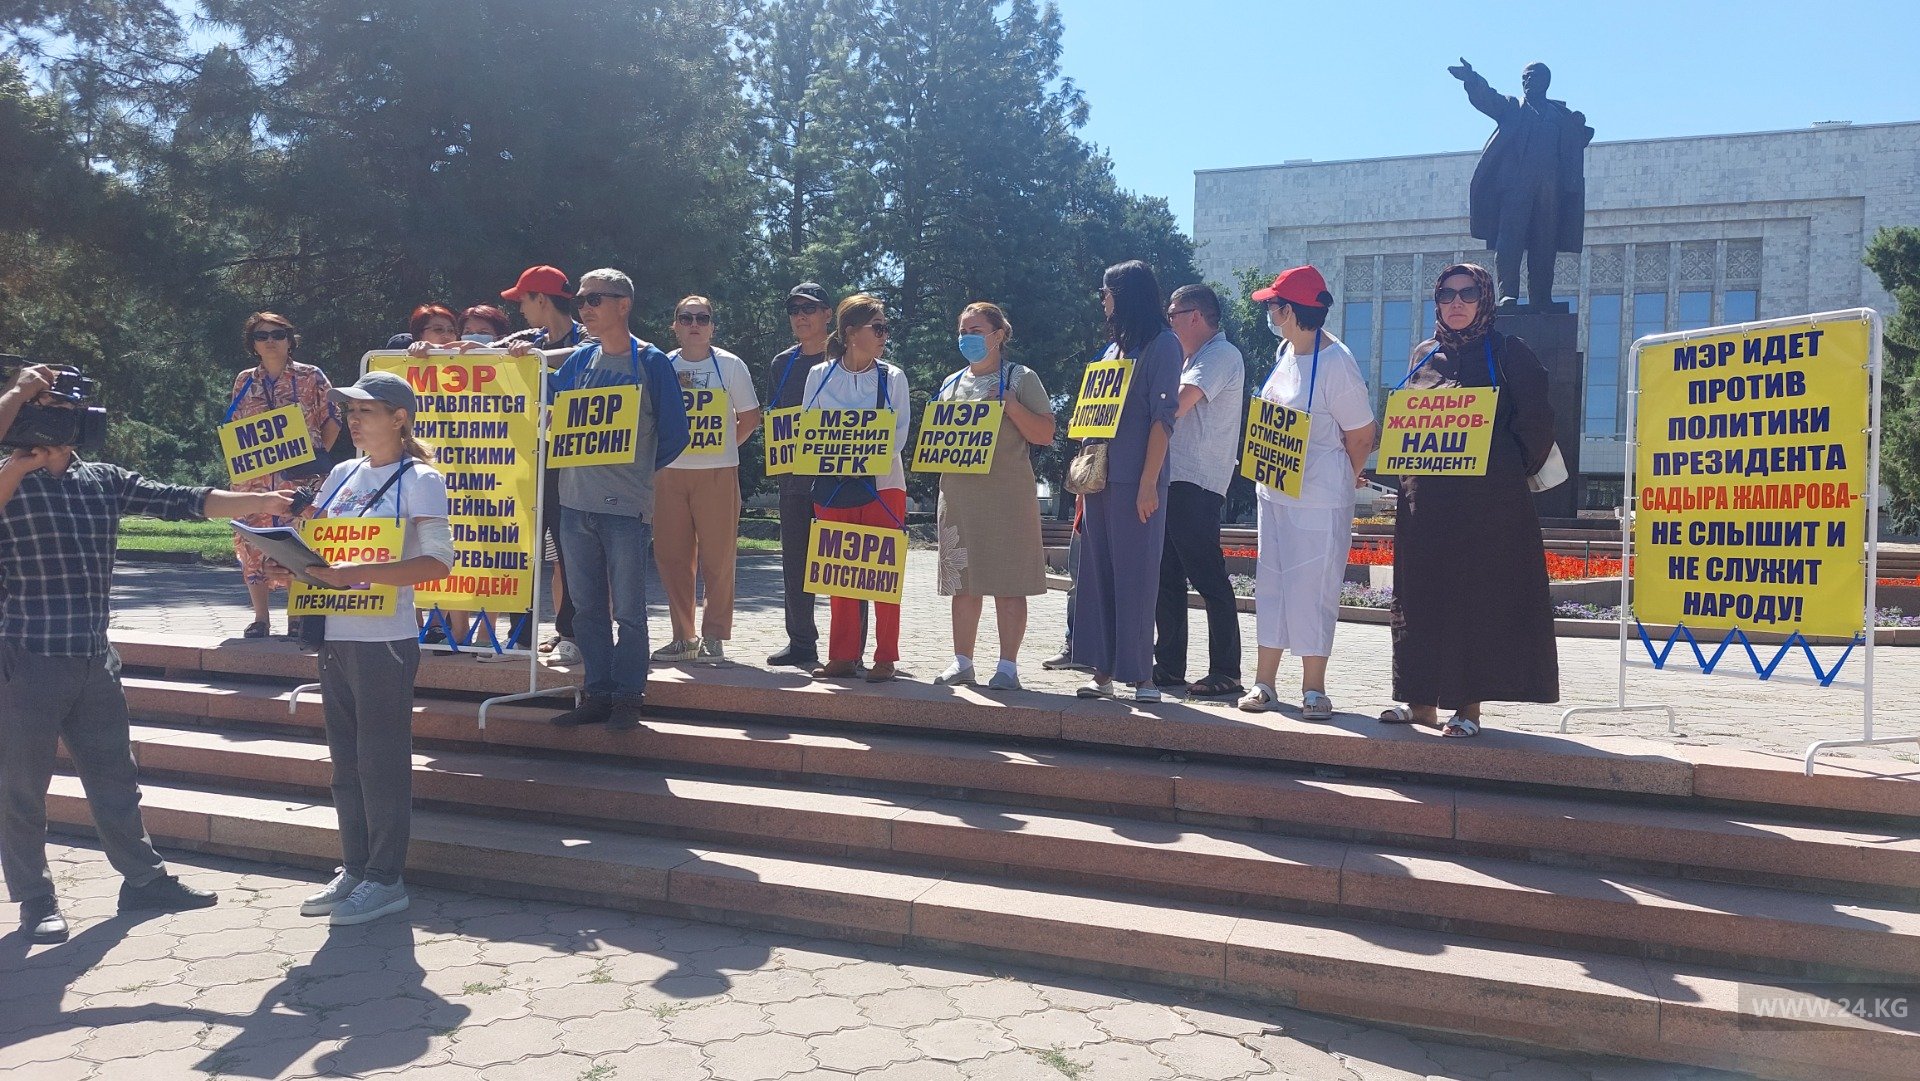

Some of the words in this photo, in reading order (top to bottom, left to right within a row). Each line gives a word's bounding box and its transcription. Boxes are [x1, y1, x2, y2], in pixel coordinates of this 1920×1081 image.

[1673, 341, 1735, 371] МЭР
[1743, 330, 1824, 366] ИДЕТ
[406, 364, 497, 393] МЭР
[1082, 367, 1126, 400] МЭРА
[1688, 370, 1806, 404] ПРОТИВ
[415, 395, 525, 413] ПРАВЛЯЕТСЯ
[567, 394, 623, 428] МЭР
[682, 390, 714, 412] ЭР
[1406, 394, 1477, 412] САДЫР
[687, 415, 723, 430] ТИВ
[820, 410, 877, 428] МЭР
[932, 403, 990, 426] МЭР
[1260, 401, 1297, 432] МЭР
[1387, 414, 1490, 430] ЖАПАРОВ-
[1668, 406, 1830, 441] ПОЛИТИКИ
[234, 413, 288, 451] МЭР
[552, 429, 632, 458] КЕТСИН!
[690, 432, 723, 450] ДА!
[804, 429, 890, 441] ОТМЕНИЛ
[920, 430, 993, 447] ПРОТИВ
[1250, 423, 1303, 454] ОТМЕНИЛ
[1401, 431, 1468, 453] НАШ
[230, 436, 308, 475] КЕТСИН!
[434, 446, 516, 465] ИСТКИМИ
[769, 446, 778, 467] В
[780, 443, 798, 465] ОТ
[802, 443, 888, 456] РЕШЕНИЕ
[918, 447, 988, 467] НАРОДА!
[1247, 440, 1301, 473] РЕШЕНИЕ
[1653, 443, 1847, 477] ПРЕЗИДЕНТА
[818, 456, 869, 474] БГК
[1255, 459, 1287, 491] БГК
[1386, 456, 1477, 472] ПРЕЗИДЕНТ!
[445, 473, 503, 492] ДАМИ-
[447, 494, 516, 517] ЕЙНЫЙ
[1641, 485, 1729, 514] САДЫРА
[1733, 482, 1858, 510] ЖАПАРОВА-
[313, 525, 381, 543] САДЫР
[449, 521, 520, 544] ЛЬНЫЙ
[1651, 521, 1682, 545] НЕ
[1688, 521, 1820, 547] СЛЫШИТ
[1826, 521, 1846, 547] И
[322, 547, 397, 562] ПАРОВ-
[817, 527, 897, 567] МЭРА
[453, 550, 529, 570] РЕВЫШЕ
[1668, 556, 1699, 580] НЕ
[1706, 556, 1822, 585] СЛУЖИТ
[444, 573, 519, 597] ЛЮДЕЙ!
[809, 561, 820, 583] В
[822, 562, 899, 594] ОТСТАВКУ!
[294, 594, 385, 612] ПРЕЗИДЕНТ!
[1683, 591, 1804, 625] НАРОДУ!
